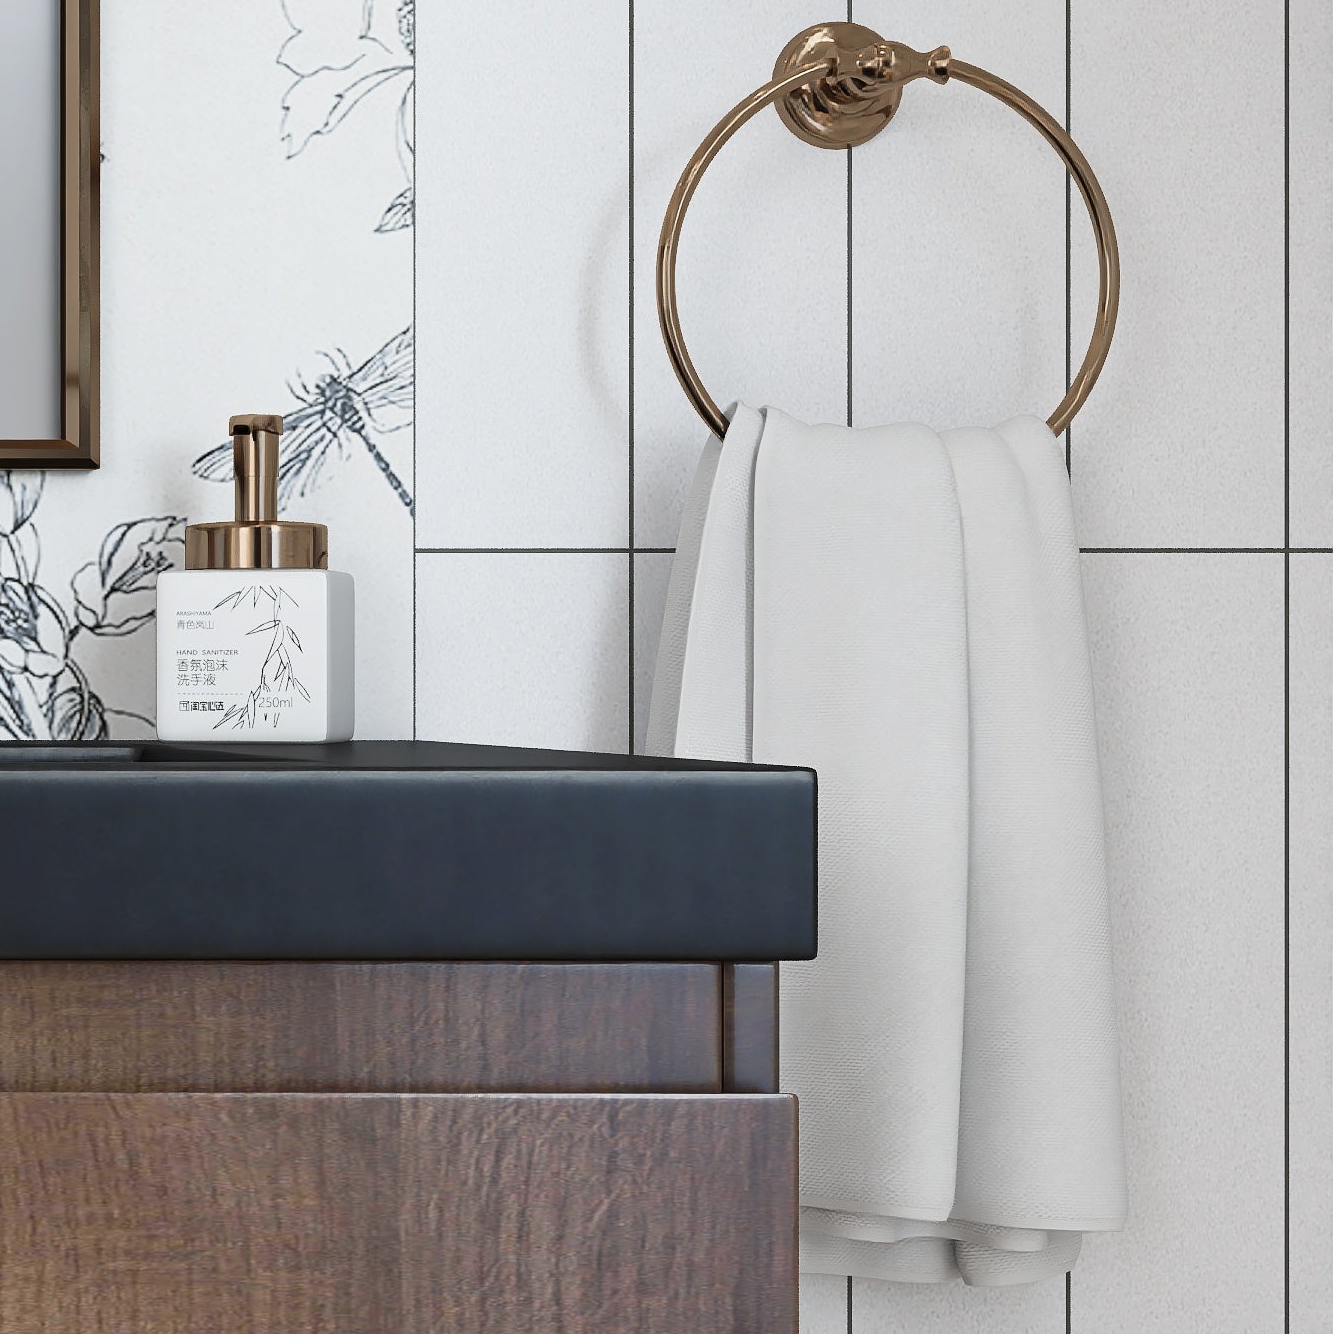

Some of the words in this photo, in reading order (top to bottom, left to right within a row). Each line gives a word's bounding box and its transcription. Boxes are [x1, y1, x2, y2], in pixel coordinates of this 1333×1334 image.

[176, 658, 229, 672] 香氛泡沫
[176, 673, 216, 686] 洗手液
[258, 696, 293, 708] 250ml
